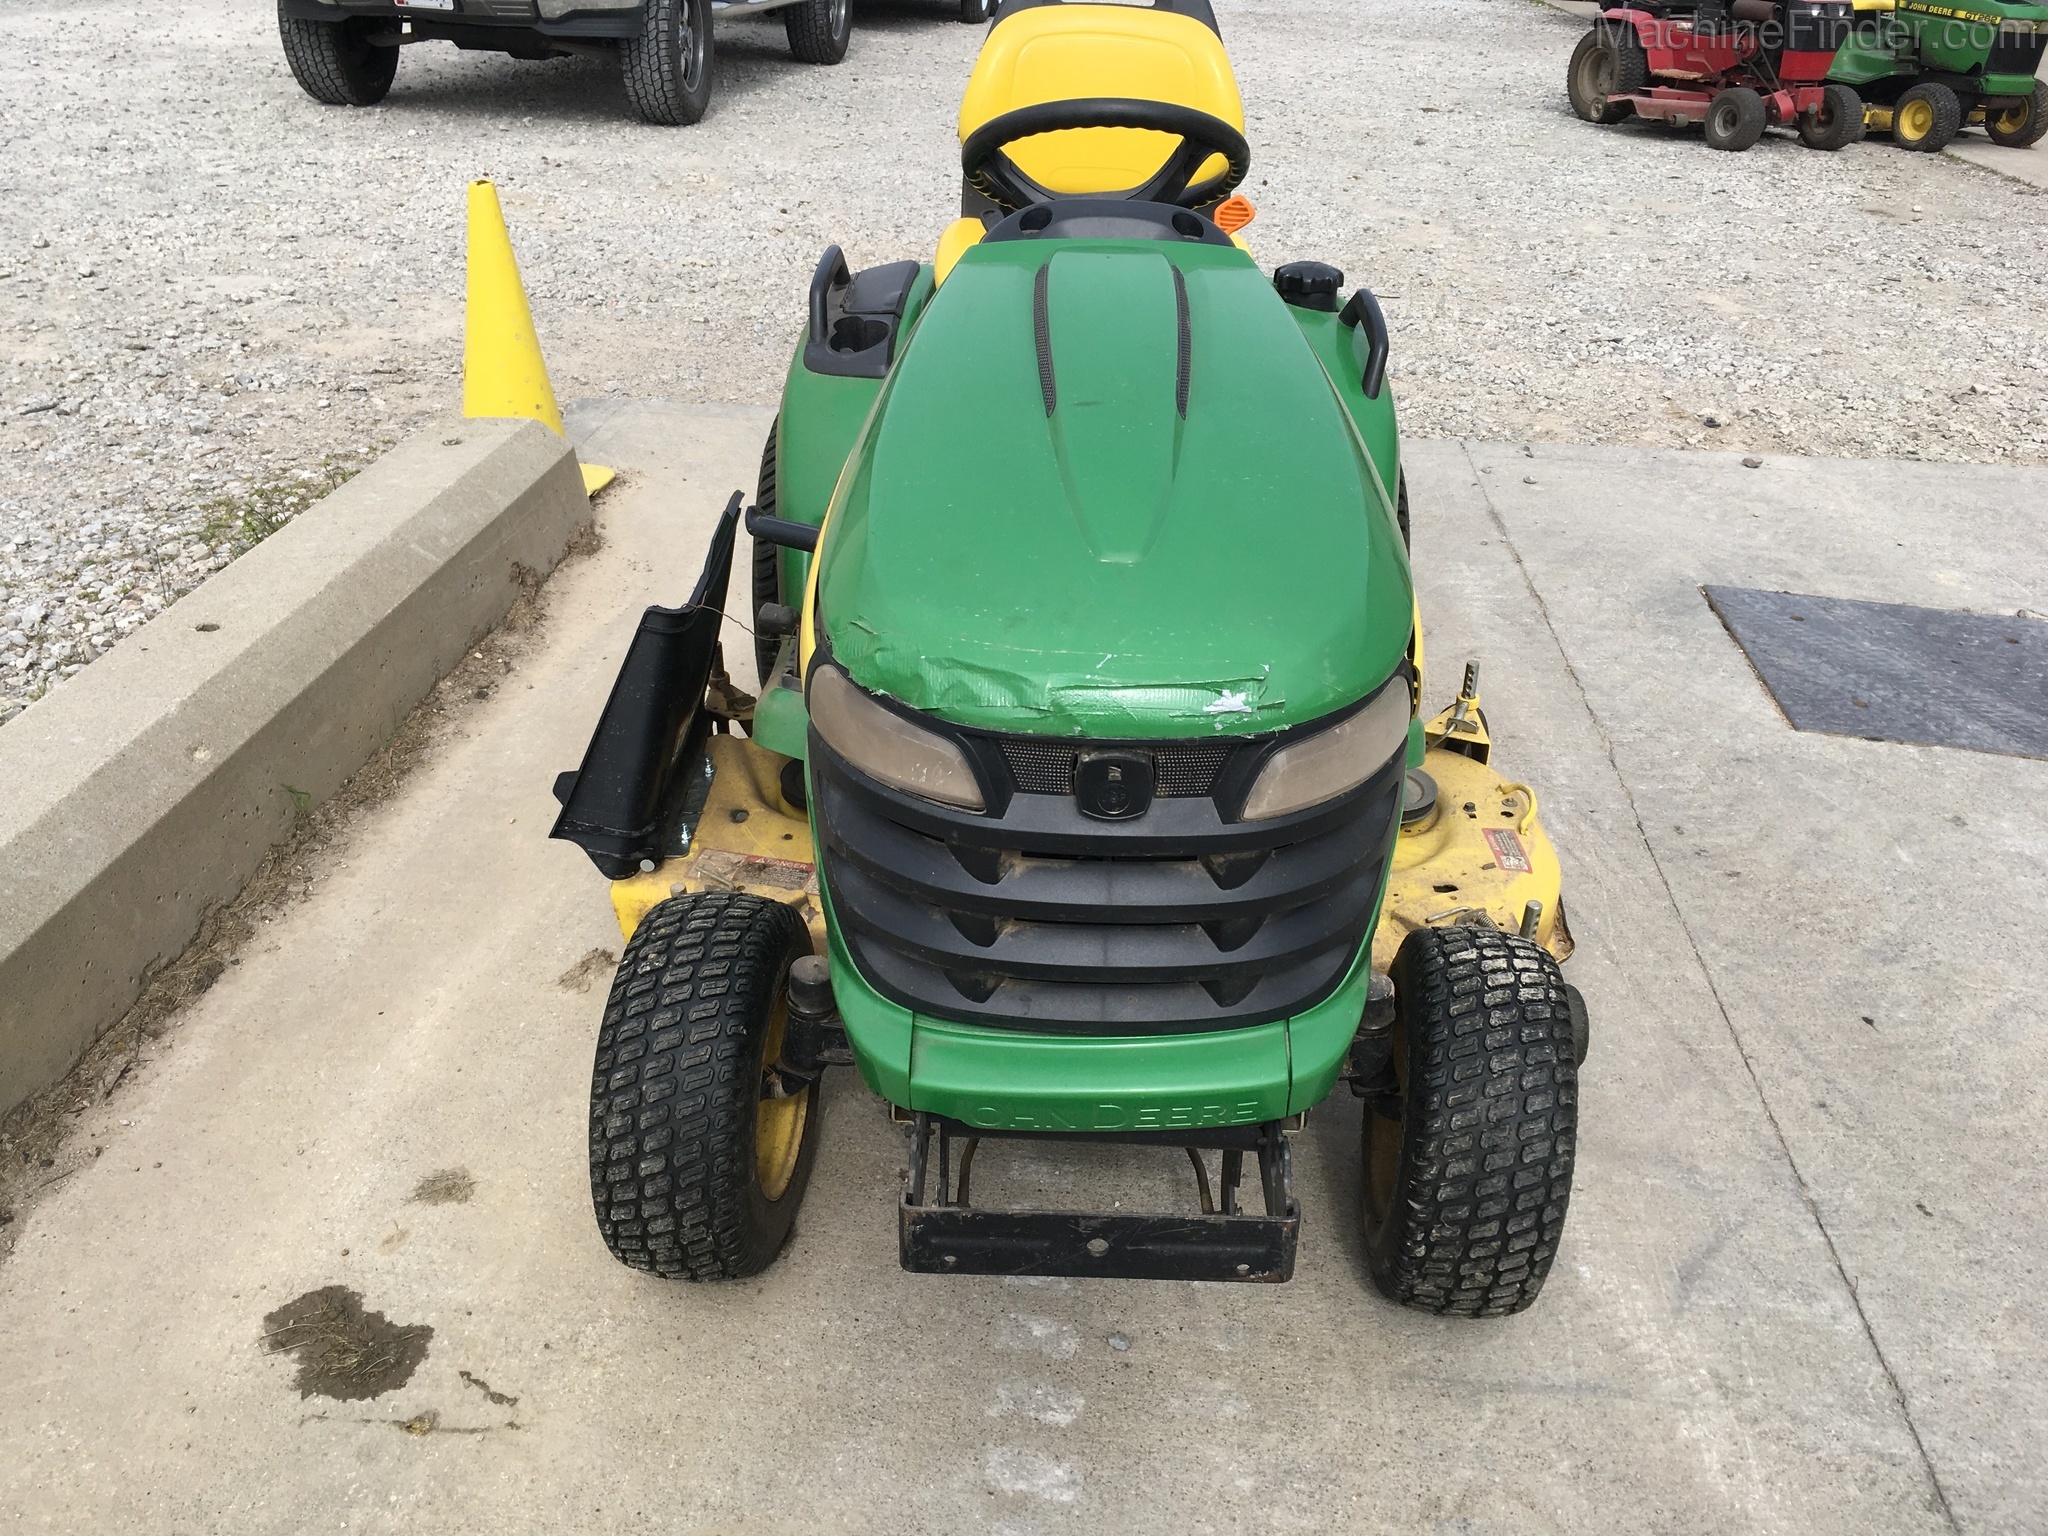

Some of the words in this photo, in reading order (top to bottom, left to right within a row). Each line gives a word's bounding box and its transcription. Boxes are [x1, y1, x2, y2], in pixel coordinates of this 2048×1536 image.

[1908, 2, 1927, 11] JOHN
[1928, 5, 1953, 16] DEERE
[1094, 1101, 1258, 1129] DEERE
